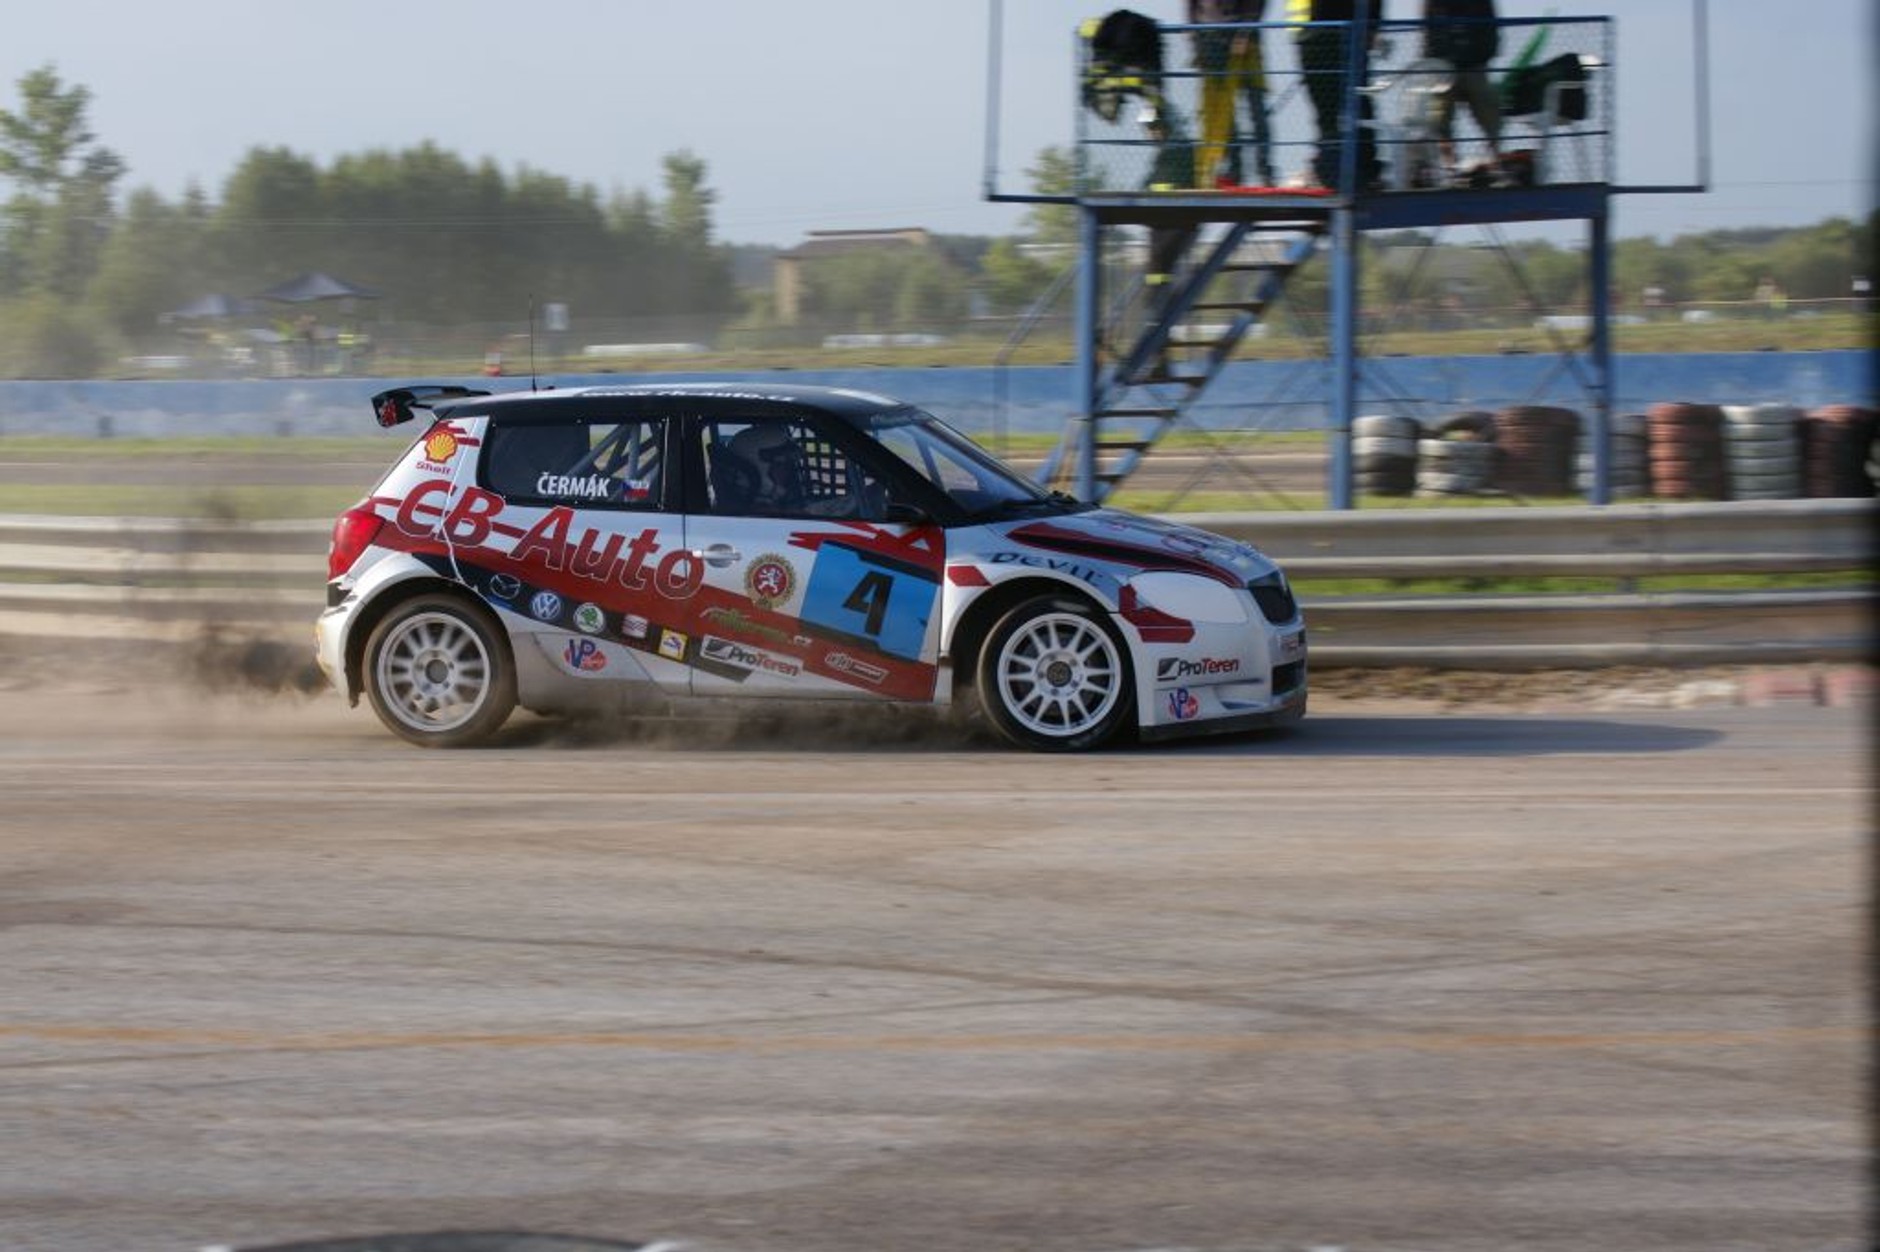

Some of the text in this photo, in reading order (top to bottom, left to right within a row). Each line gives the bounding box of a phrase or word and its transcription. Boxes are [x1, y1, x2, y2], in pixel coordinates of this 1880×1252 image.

[537, 471, 610, 500] ČERMÁK
[843, 571, 894, 635] 4
[730, 645, 799, 677] ProTeren
[1178, 658, 1239, 676] ProTeren
